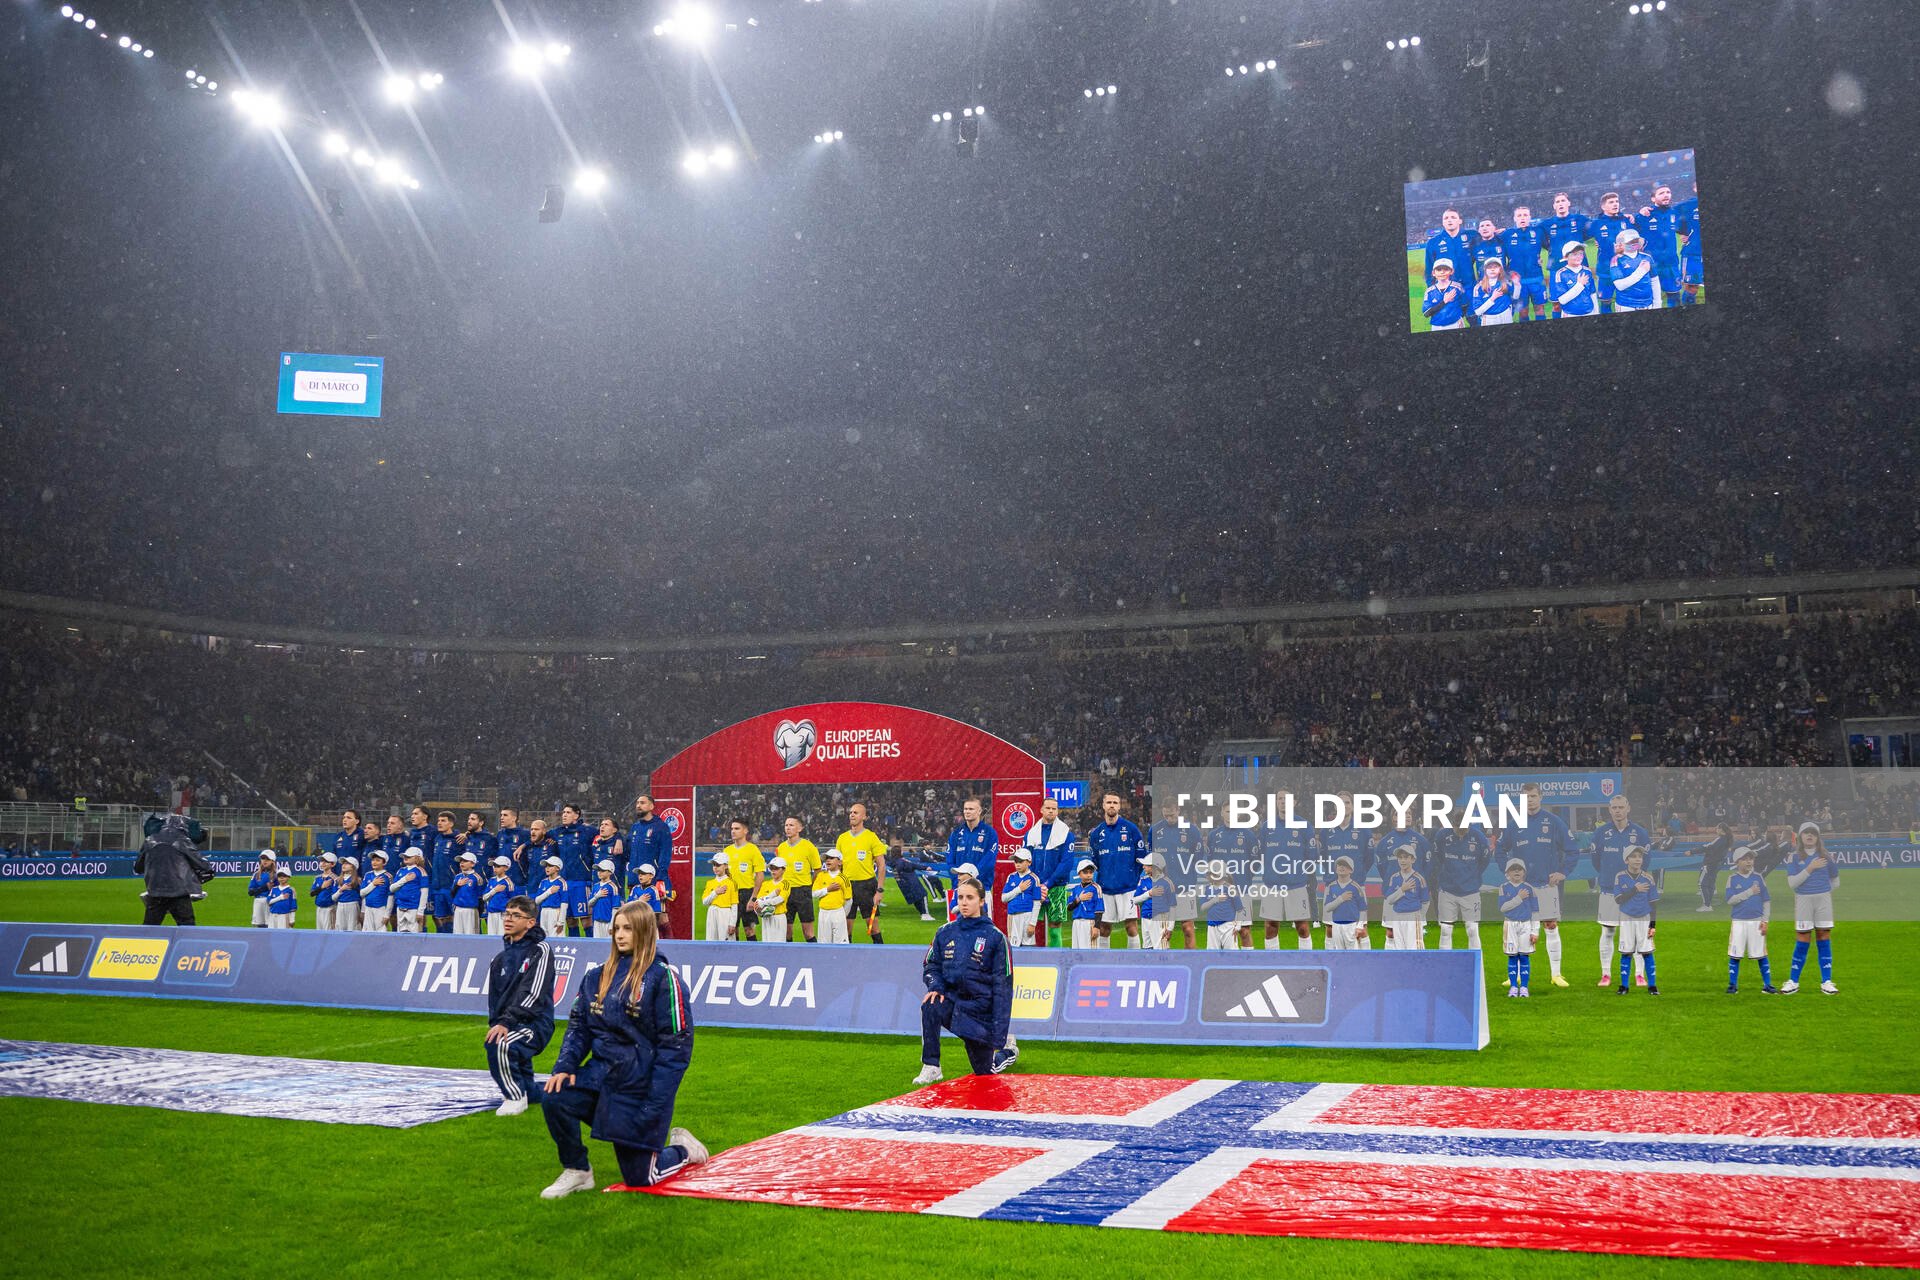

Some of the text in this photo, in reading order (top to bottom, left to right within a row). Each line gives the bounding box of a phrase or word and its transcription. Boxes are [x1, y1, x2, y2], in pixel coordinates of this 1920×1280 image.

[309, 381, 360, 392] DI MARCO
[825, 729, 892, 743] EUROPEAN
[816, 743, 901, 762] QUALIFIERS
[1051, 787, 1078, 801] TIM
[663, 809, 681, 818] UEFA
[1008, 804, 1028, 813] UEFA
[998, 844, 1022, 854] RESP
[2, 862, 107, 876] GIUOCO CALCIO
[577, 902, 587, 913] 21
[109, 950, 160, 965] Telepass
[177, 951, 210, 973] eni
[1116, 980, 1178, 1009] TIM
